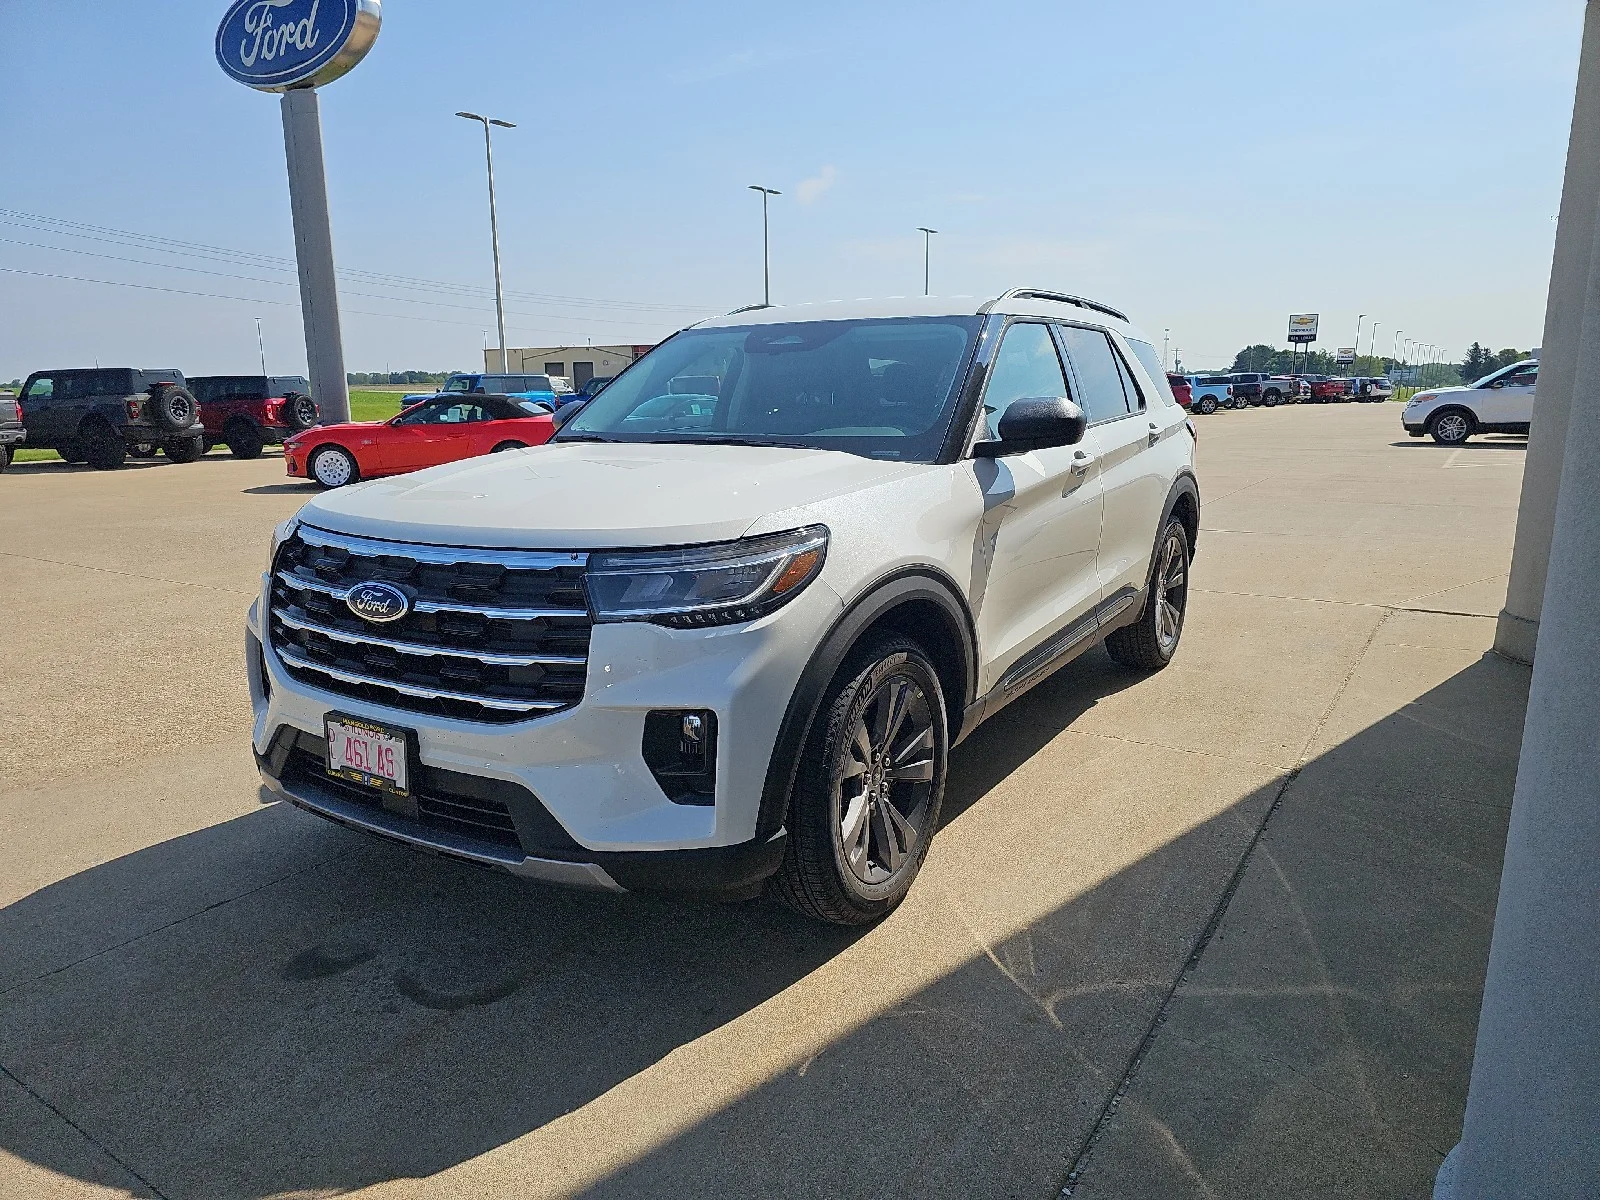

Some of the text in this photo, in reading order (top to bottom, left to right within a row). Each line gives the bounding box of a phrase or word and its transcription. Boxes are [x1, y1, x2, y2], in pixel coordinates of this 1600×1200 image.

[240, 0, 320, 67] Ford
[355, 589, 391, 613] Ford
[351, 726, 380, 740] ILLINOIS
[346, 737, 394, 778] 461 AS
